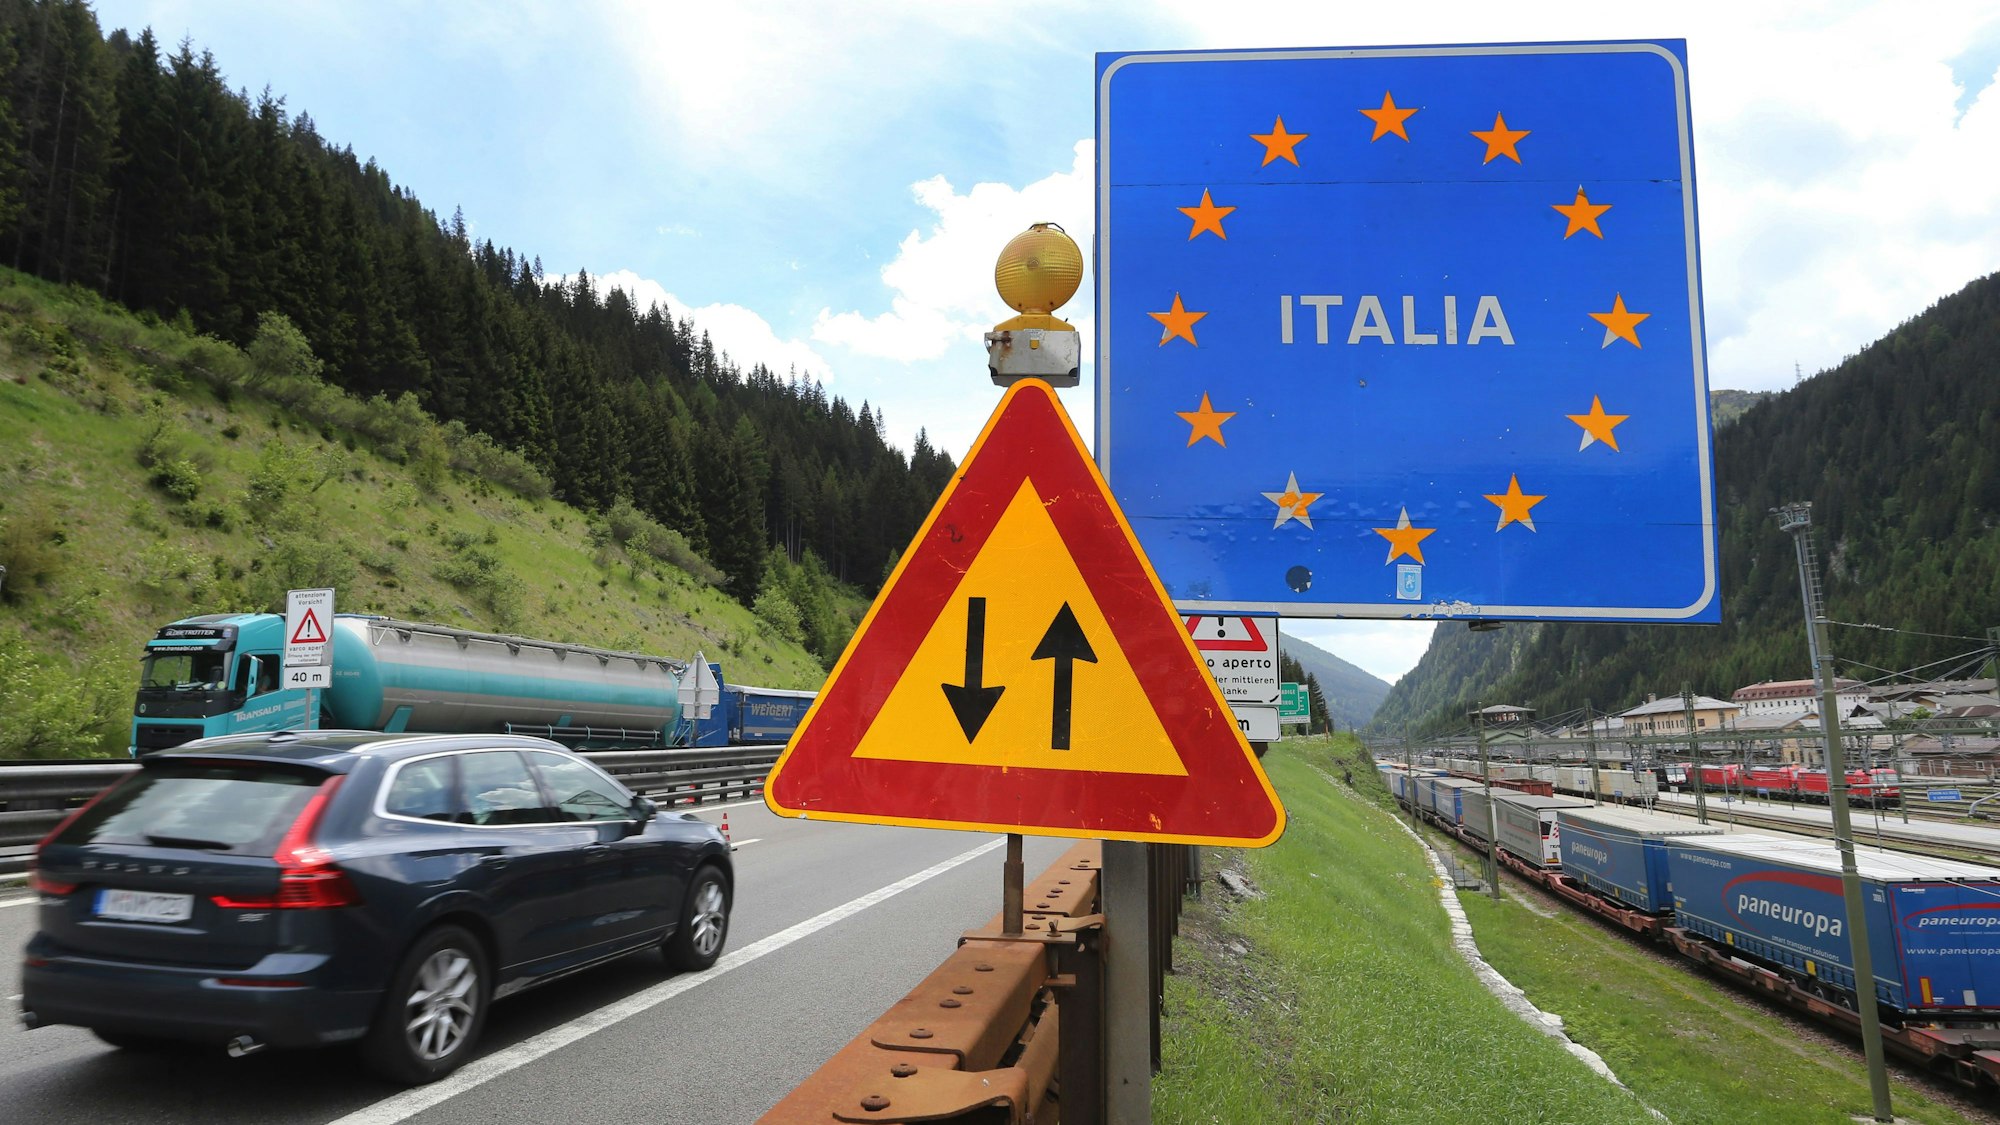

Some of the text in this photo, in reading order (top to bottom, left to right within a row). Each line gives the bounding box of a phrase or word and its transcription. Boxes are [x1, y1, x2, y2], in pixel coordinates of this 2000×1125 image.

[1281, 295, 1515, 345] ITALIA
[165, 628, 216, 637] GLOBETROTTER
[1223, 659, 1271, 670] aperto
[291, 672, 322, 682] 40 m
[1232, 676, 1275, 684] mittleren
[1222, 687, 1248, 695] lanke
[1571, 841, 1608, 864] paneuropa
[1680, 853, 1732, 869] www.paneuropa.com
[1738, 894, 1842, 937] paneuropa
[1772, 935, 1840, 962] smart transport solutions
